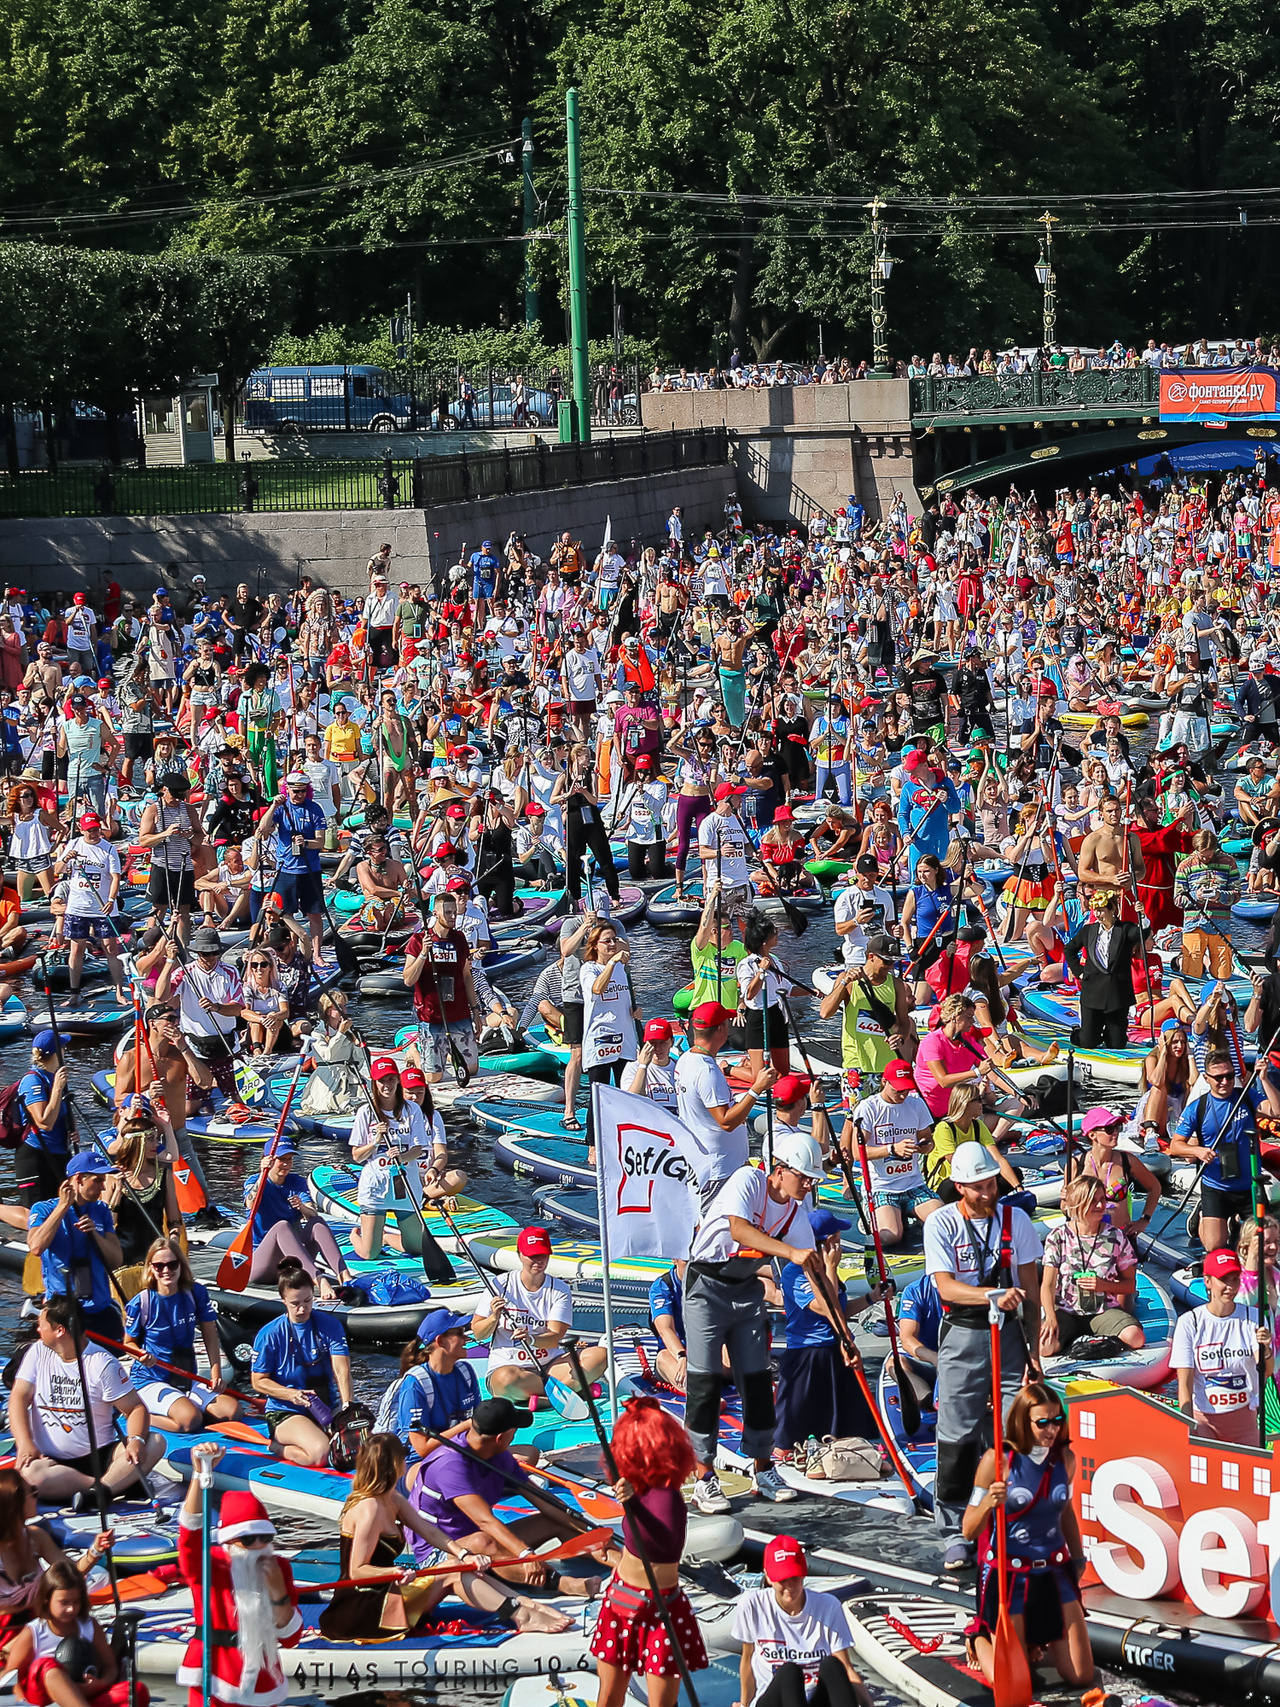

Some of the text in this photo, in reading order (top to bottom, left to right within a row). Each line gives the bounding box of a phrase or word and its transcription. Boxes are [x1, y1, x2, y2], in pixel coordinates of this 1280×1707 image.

[1189, 383, 1265, 402] фонтанка.ру
[598, 1045, 622, 1057] 0540
[241, 1078, 261, 1094] PRO
[371, 1126, 410, 1137] SGrou
[877, 1127, 916, 1139] SetlGroup
[886, 1162, 913, 1175] 0486
[1208, 1392, 1247, 1406] 0558
[763, 1646, 827, 1661] SetlGroup
[1124, 1643, 1176, 1672] TIGER
[293, 1653, 591, 1679] ATLAS TOURING 10.6
